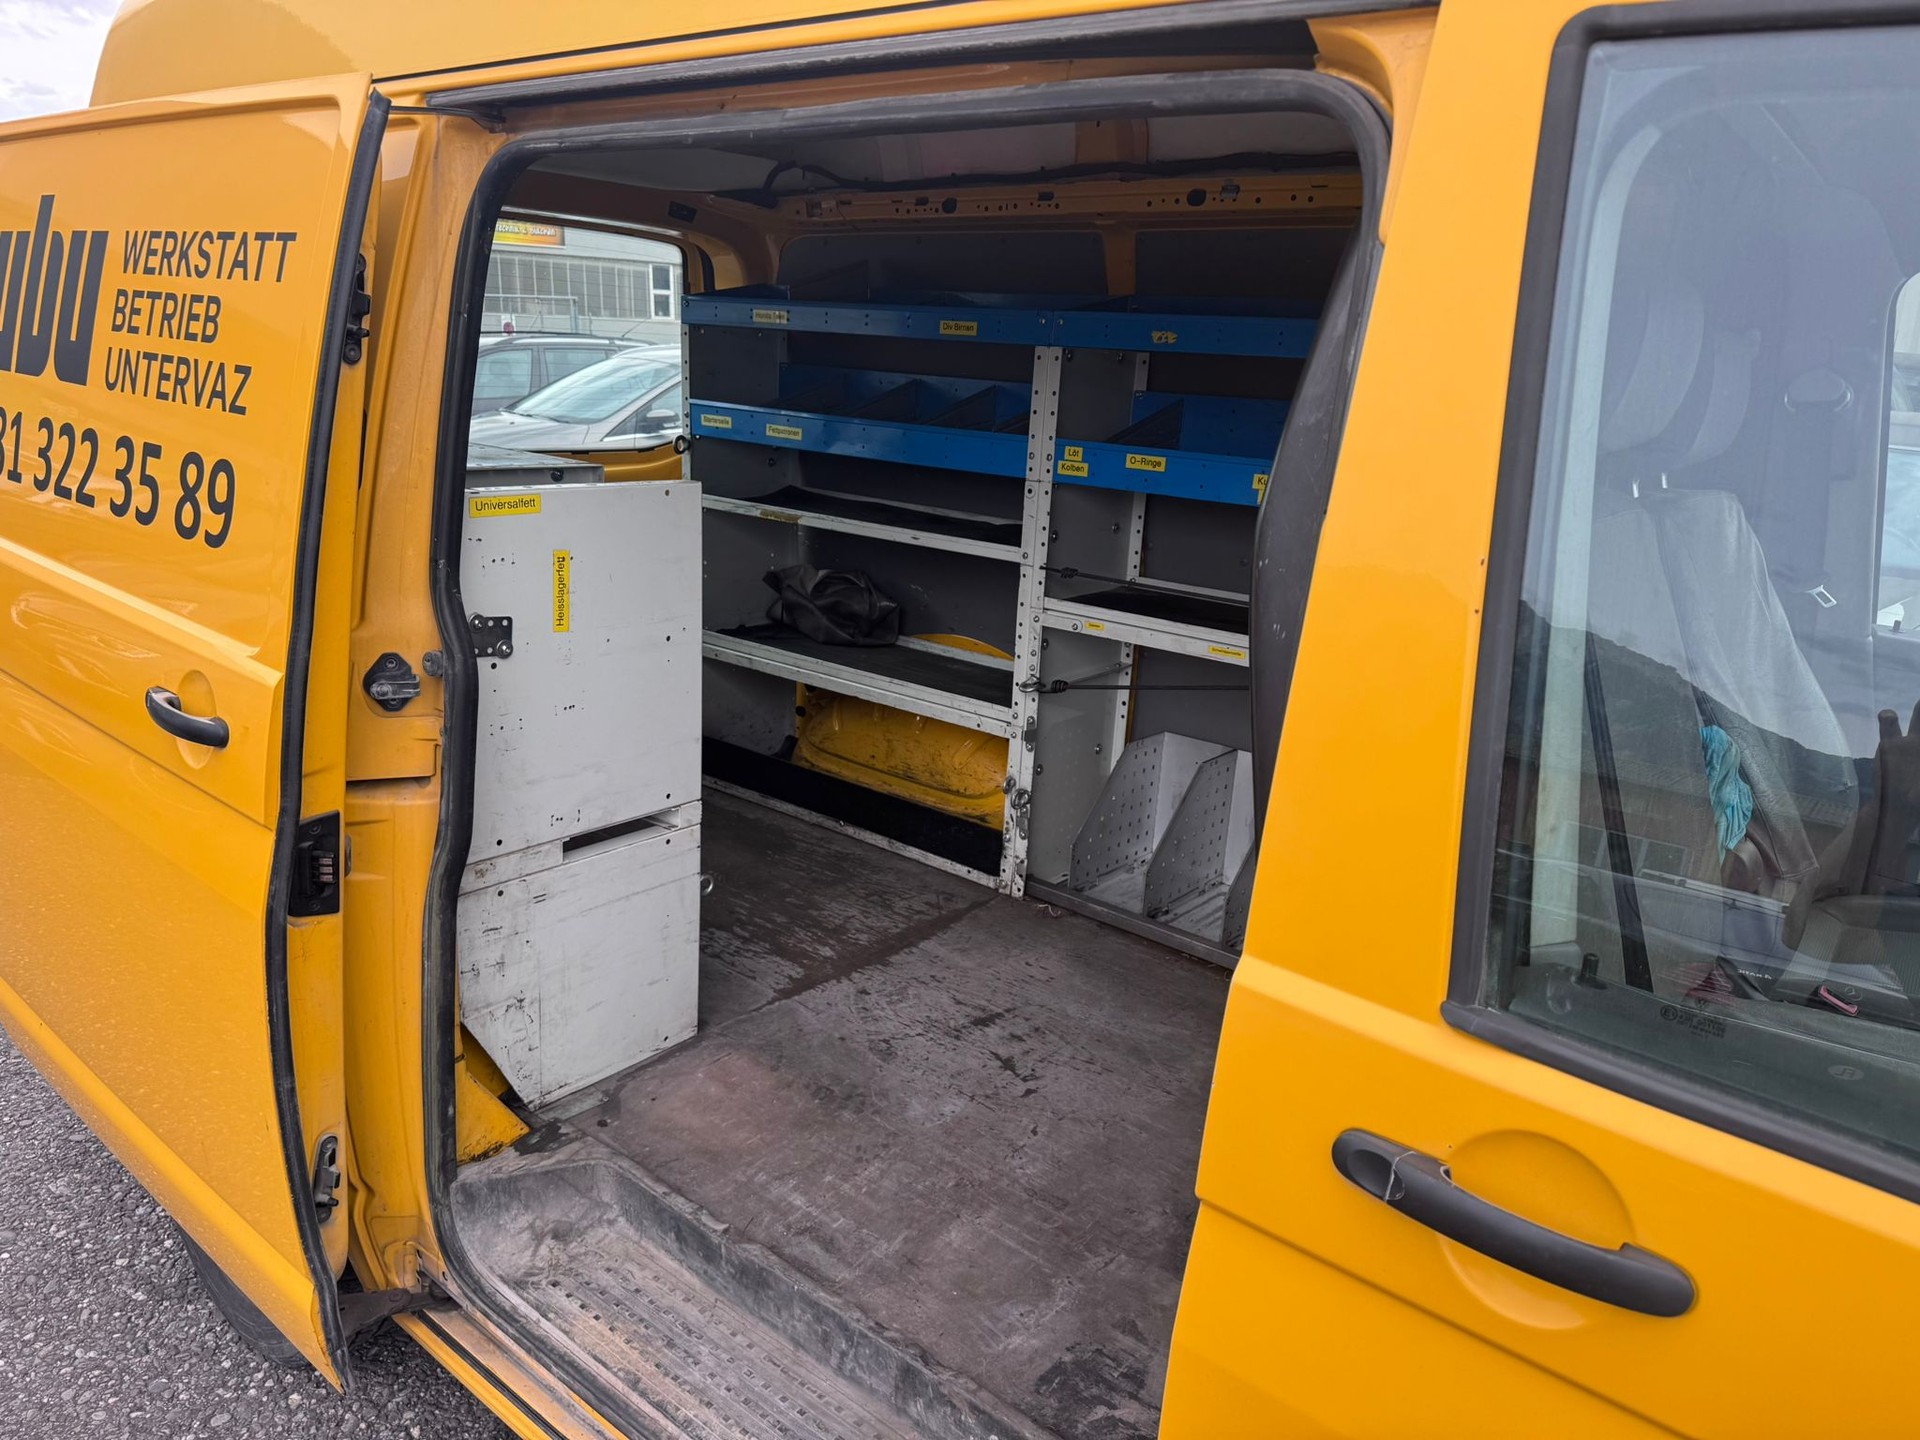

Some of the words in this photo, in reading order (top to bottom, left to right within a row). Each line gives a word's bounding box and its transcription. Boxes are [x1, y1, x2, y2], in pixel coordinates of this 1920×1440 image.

[122, 230, 297, 283] WERKSTATT
[111, 288, 221, 344] BETRIEB
[105, 347, 253, 416] UNTERVAZ
[33, 416, 99, 508] 322
[109, 435, 162, 526] 35
[174, 451, 235, 549] 89
[1061, 462, 1085, 473] Kolben
[1129, 456, 1162, 469] O-Ringe
[475, 498, 536, 512] Universalfett
[555, 556, 566, 627] Heisslagerfett
